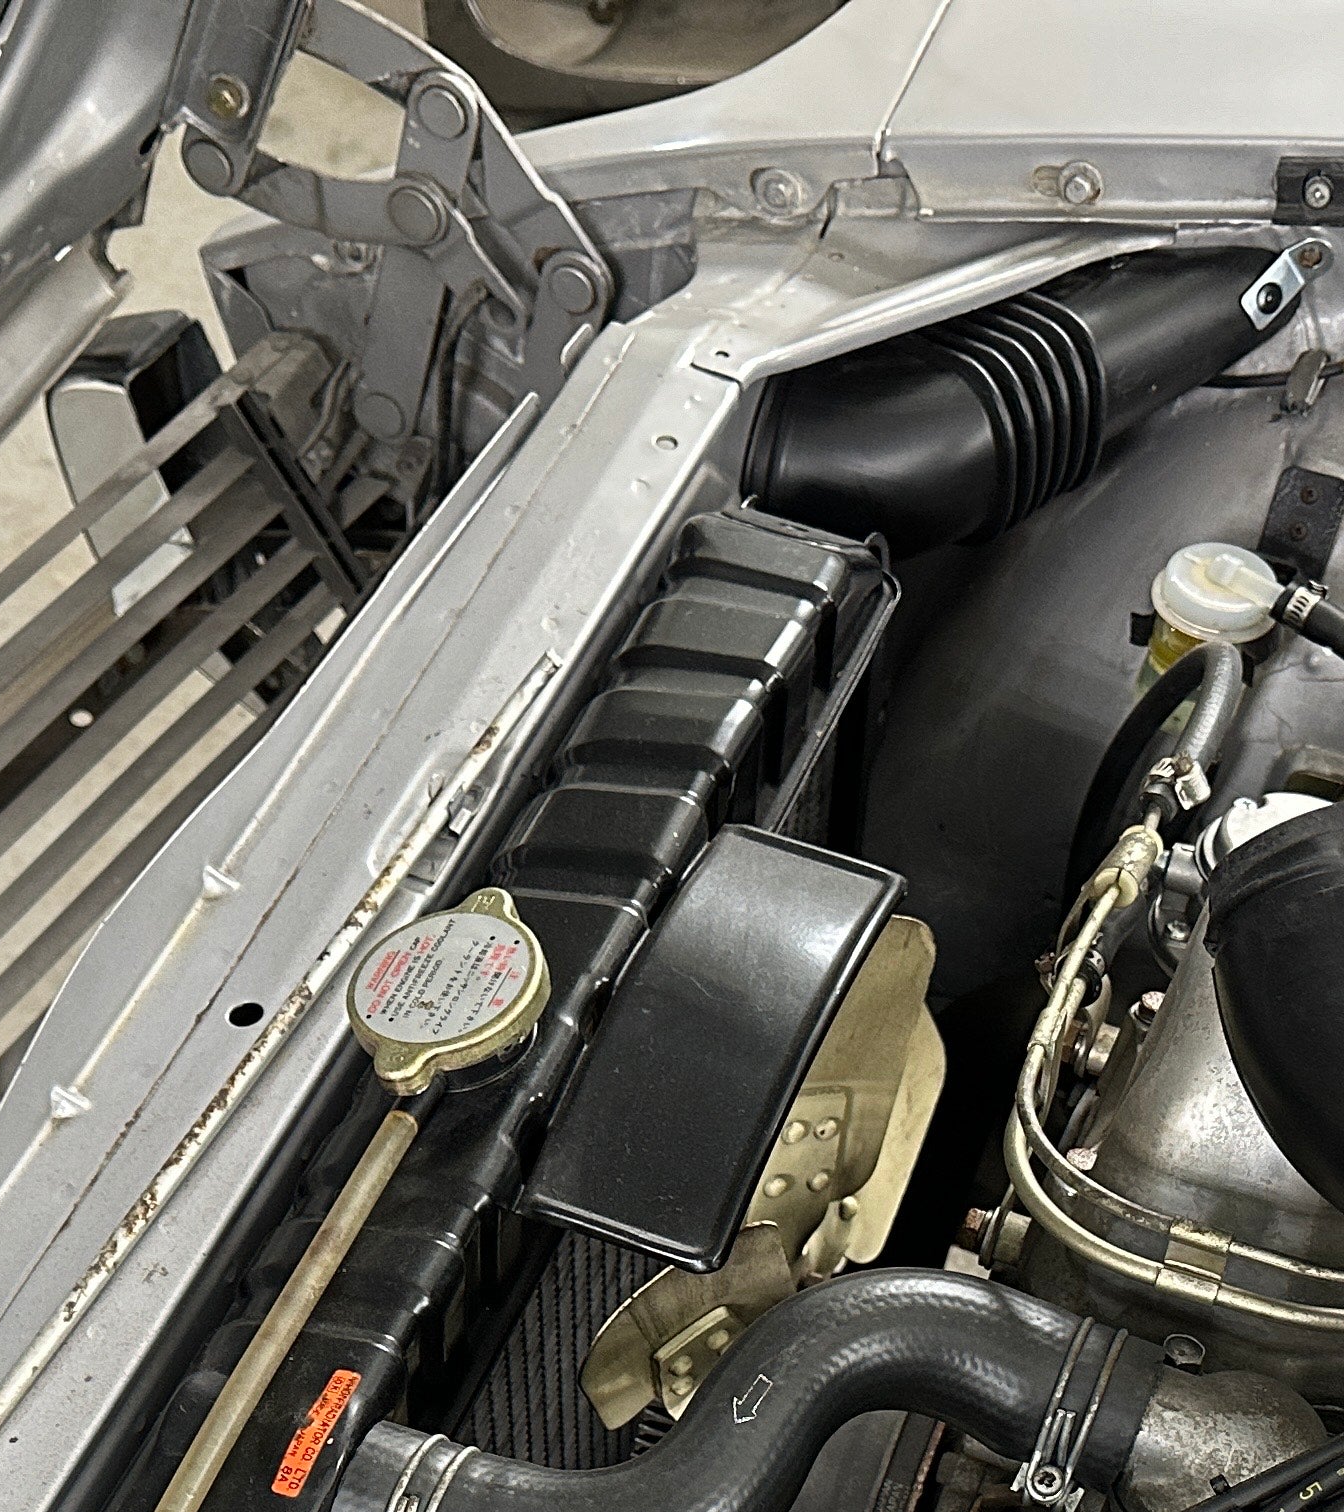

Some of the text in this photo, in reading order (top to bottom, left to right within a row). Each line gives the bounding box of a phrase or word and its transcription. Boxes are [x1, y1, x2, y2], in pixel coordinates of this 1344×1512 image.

[389, 999, 404, 1016] USE
[430, 917, 456, 954] COOLANT
[375, 978, 393, 999] NOT
[379, 991, 398, 1017] WHEN
[394, 963, 416, 993] ENGINE
[312, 1398, 342, 1445] RADIATOR
[277, 1465, 293, 1482] 8A
[1299, 1481, 1323, 1500] 5
